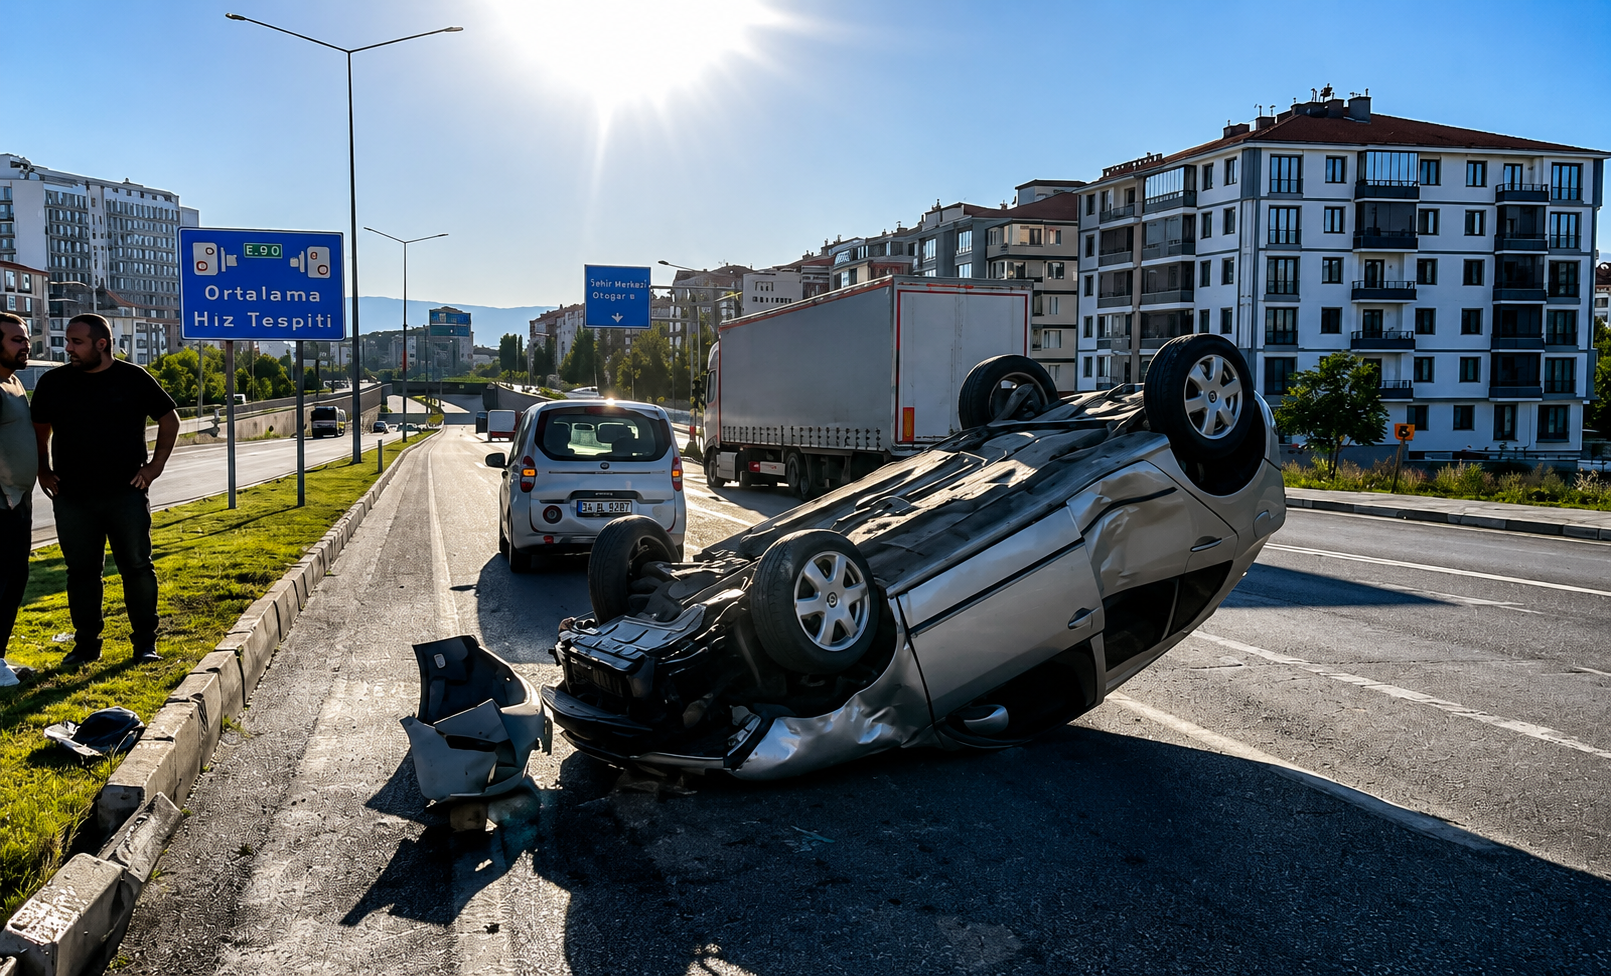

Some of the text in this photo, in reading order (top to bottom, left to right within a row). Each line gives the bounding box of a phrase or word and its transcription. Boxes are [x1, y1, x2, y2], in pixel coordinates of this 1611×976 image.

[204, 284, 321, 302] Ortalama
[592, 291, 626, 302] Otogar
[247, 312, 332, 331] Tespiti
